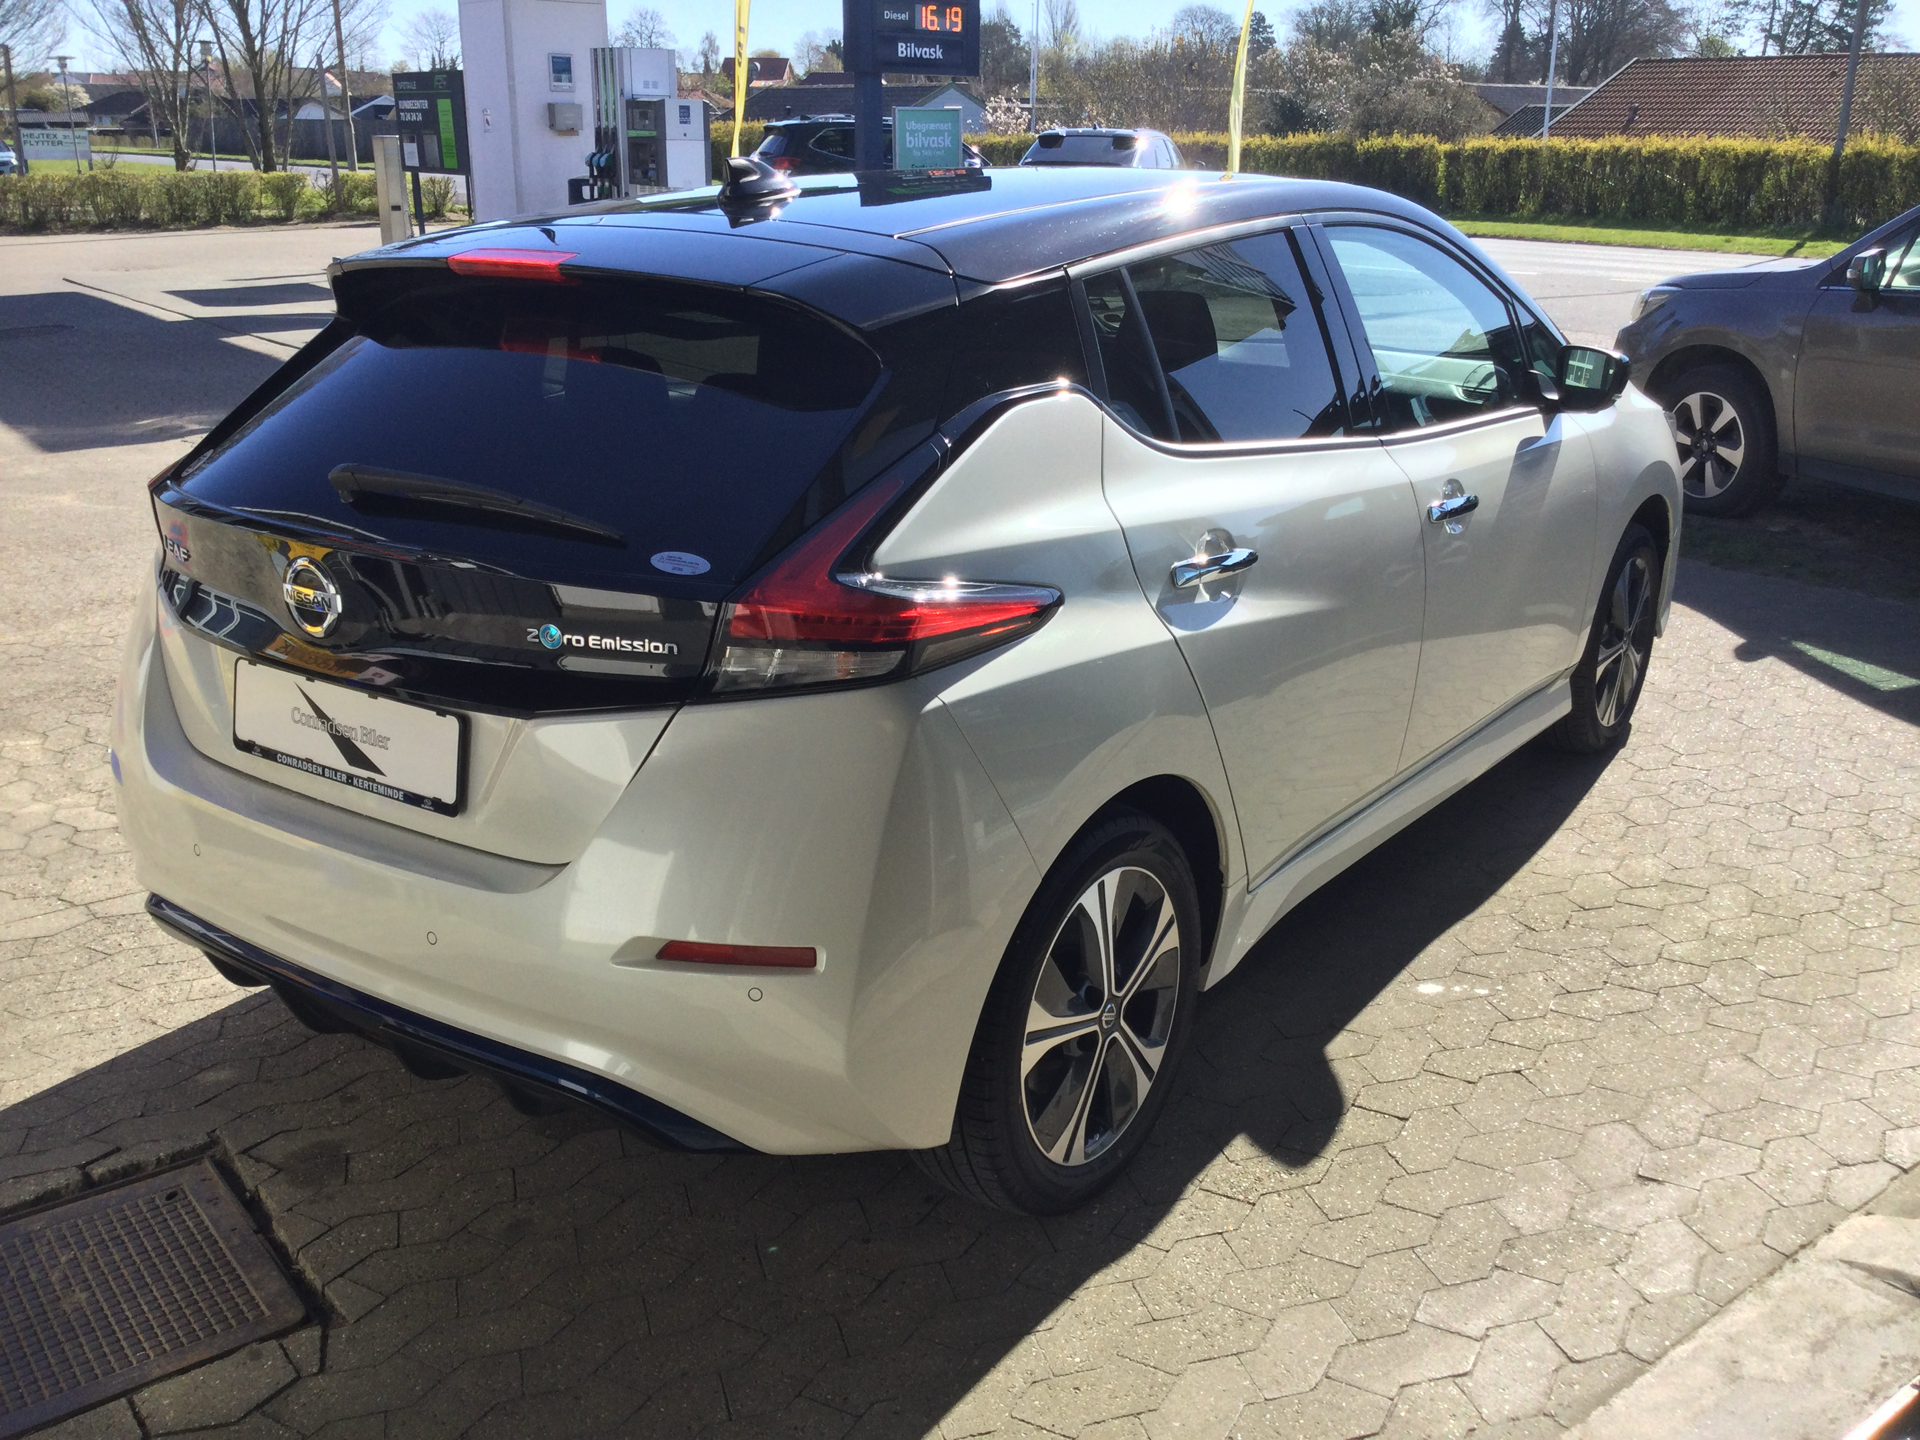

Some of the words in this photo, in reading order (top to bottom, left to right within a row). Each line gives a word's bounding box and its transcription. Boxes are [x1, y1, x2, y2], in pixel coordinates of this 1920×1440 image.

[884, 10, 909, 20] Diesel
[921, 5, 962, 32] 16.19
[898, 42, 943, 59] Bilvask
[905, 121, 952, 132] Ubegrænset
[905, 132, 952, 148] bilvask
[285, 588, 333, 610] NISSAN
[588, 635, 679, 656] Emission
[290, 706, 358, 743] Conradsen
[359, 724, 391, 750] Biler
[276, 752, 323, 776] CONRADSEN
[324, 767, 348, 784] BILER
[352, 776, 404, 801] KERTEMINDE
